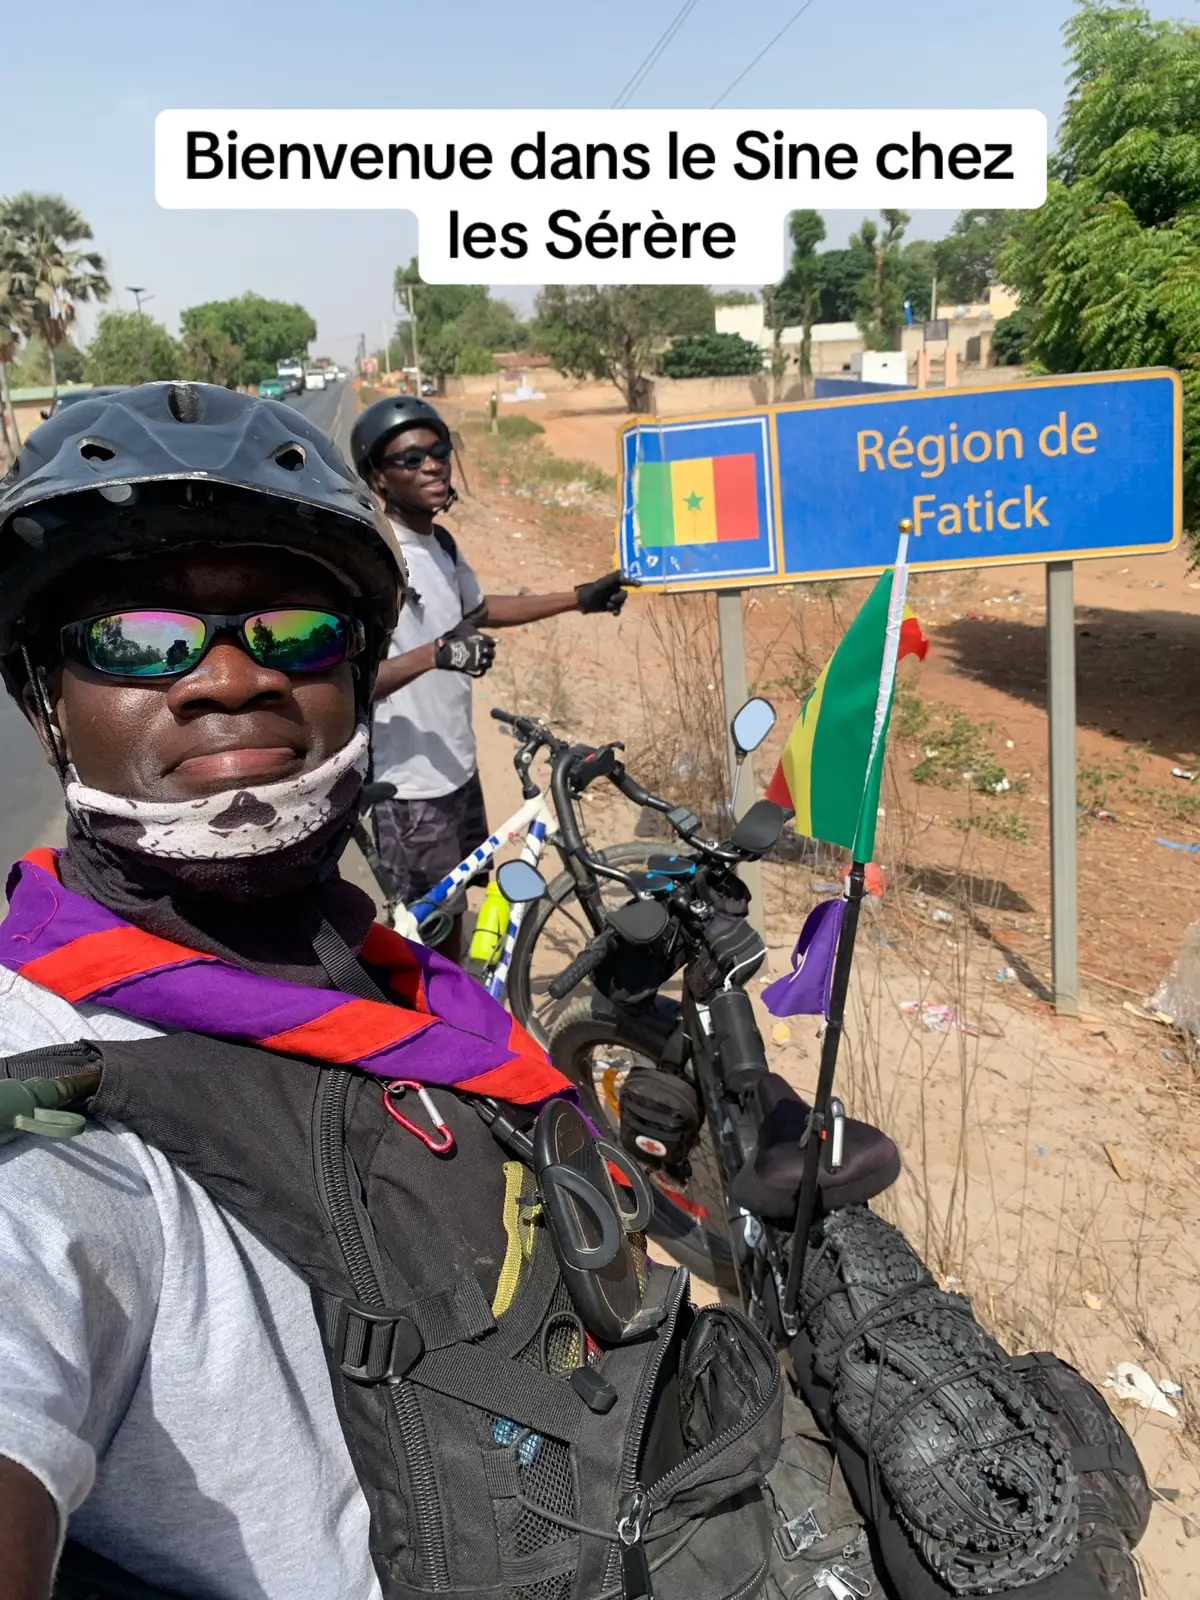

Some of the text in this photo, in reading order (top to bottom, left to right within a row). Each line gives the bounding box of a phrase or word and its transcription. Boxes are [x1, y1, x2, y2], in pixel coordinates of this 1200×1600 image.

[857, 411, 1098, 479] Région de
[912, 485, 1050, 537] Fatick
